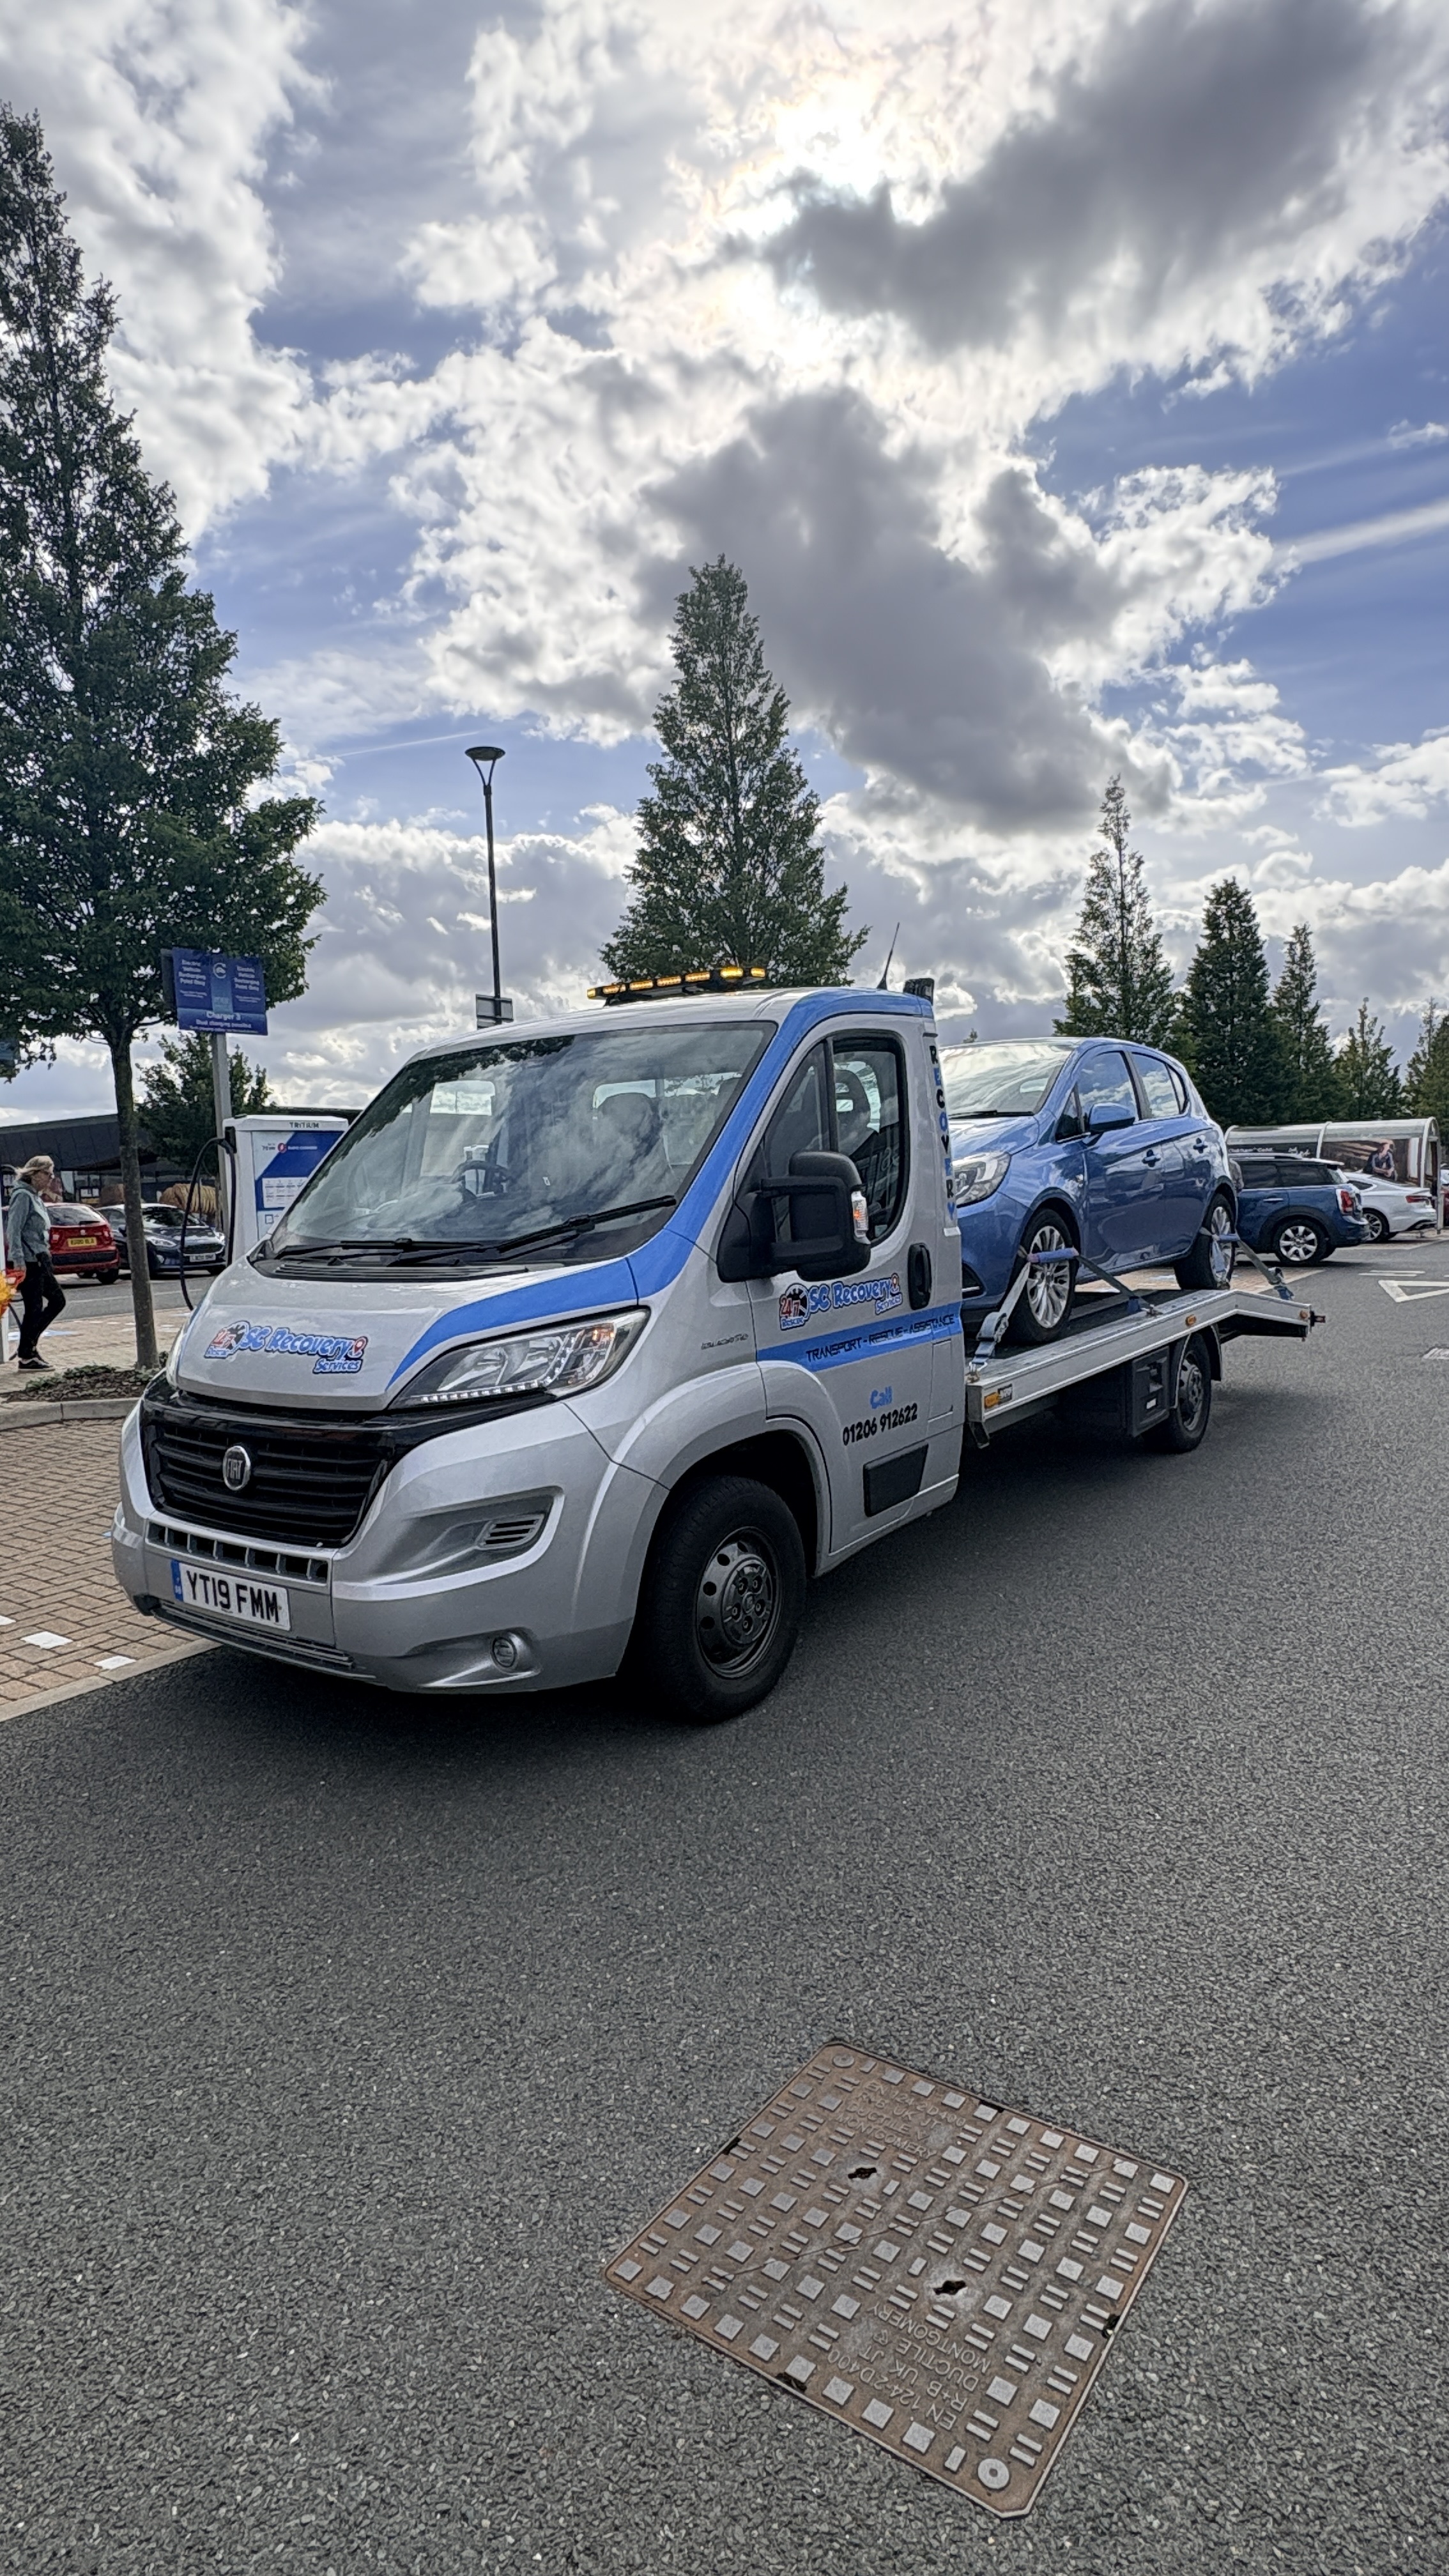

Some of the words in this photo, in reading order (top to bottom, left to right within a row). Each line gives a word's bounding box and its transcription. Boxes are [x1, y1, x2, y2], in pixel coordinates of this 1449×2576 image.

[928, 1045, 956, 1221] RECOVERY
[809, 1286, 829, 1311] SC
[832, 1279, 891, 1308] Recovery
[876, 1293, 902, 1312] Services
[240, 1328, 270, 1349] SC
[267, 1329, 354, 1361] Recovery
[806, 1337, 862, 1362] TRANSPORT
[868, 1327, 903, 1345] RESCUE
[316, 1359, 360, 1372] Services
[870, 1385, 893, 1409] Call
[843, 1416, 878, 1446] 01206
[879, 1402, 917, 1432] 912622
[186, 1570, 231, 1611] YT19
[235, 1583, 280, 1623] FMM
[845, 2102, 912, 2137] DUCTILE
[893, 2108, 917, 2121] UK
[835, 2113, 937, 2160] MONTGOMERY
[867, 2301, 991, 2374] MONTGOMERY
[858, 2345, 885, 2363] JT
[896, 2337, 979, 2392] DUCTILE
[888, 2359, 919, 2386] UK
[926, 2380, 968, 2412] R+B
[926, 2403, 957, 2430] EN
